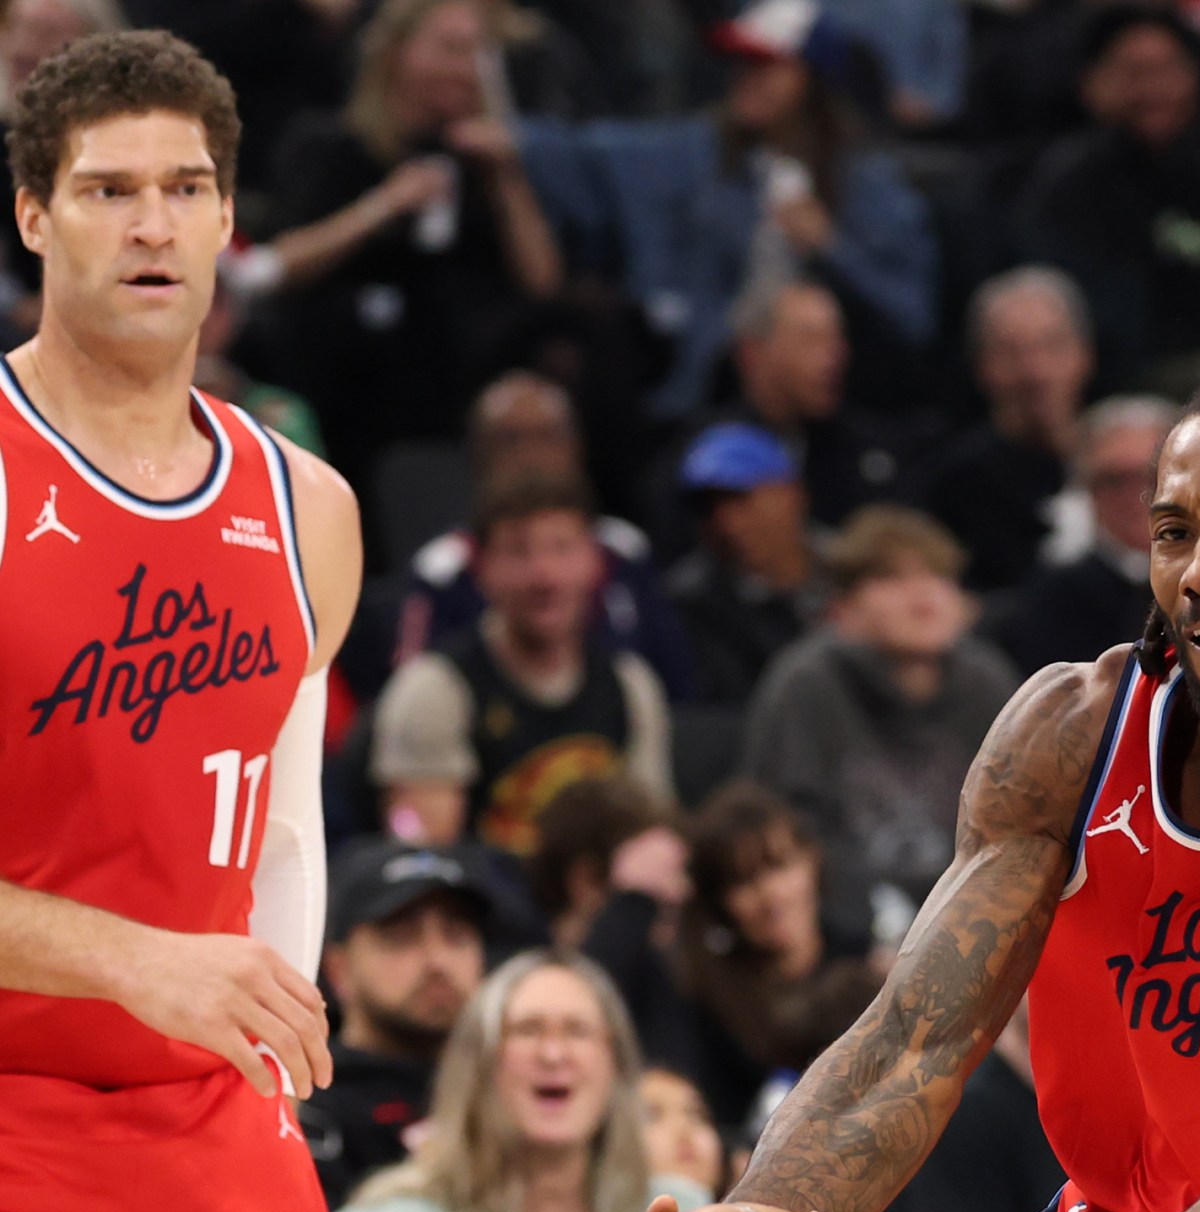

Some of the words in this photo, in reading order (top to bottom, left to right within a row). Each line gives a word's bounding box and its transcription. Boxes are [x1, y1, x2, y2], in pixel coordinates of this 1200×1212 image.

[230, 515, 266, 536] VISIT
[114, 562, 216, 650] Los
[27, 608, 280, 744] Angeles
[203, 749, 269, 870] 11
